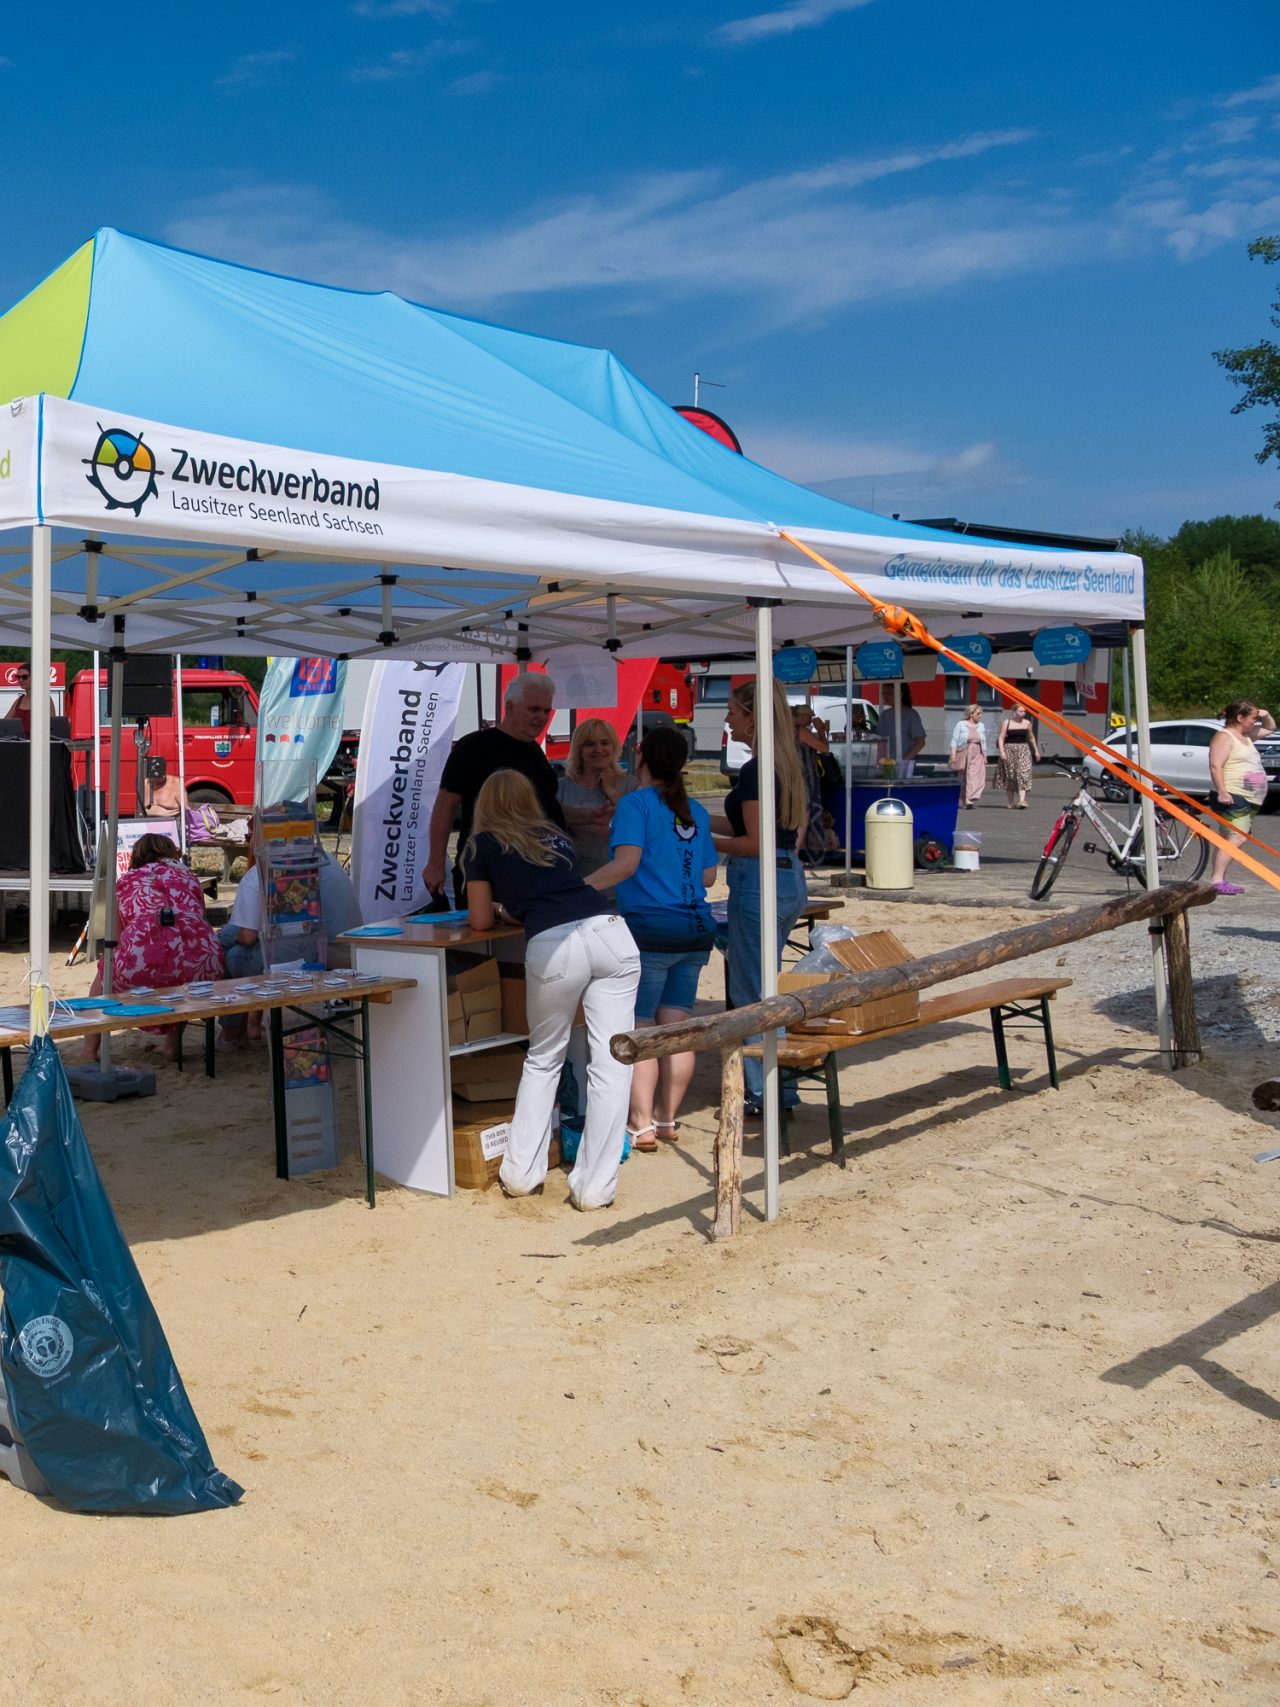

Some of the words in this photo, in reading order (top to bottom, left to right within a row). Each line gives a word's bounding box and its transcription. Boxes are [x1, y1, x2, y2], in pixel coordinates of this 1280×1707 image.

[170, 448, 380, 511] Zweckverband
[172, 491, 245, 518] Lausitzer
[248, 501, 320, 528] Seenland
[322, 513, 384, 536] Sachsen
[884, 553, 971, 586] Gemeinsam
[975, 559, 995, 587] für
[999, 560, 1021, 589] das
[1024, 563, 1083, 592] Lausitzer
[1083, 564, 1136, 595] Seenland
[266, 711, 340, 730] welcome
[417, 691, 439, 756] Sachsen
[374, 689, 422, 902] Zweckverband
[407, 758, 426, 829] Seenland
[401, 832, 417, 902] Lausitzer
